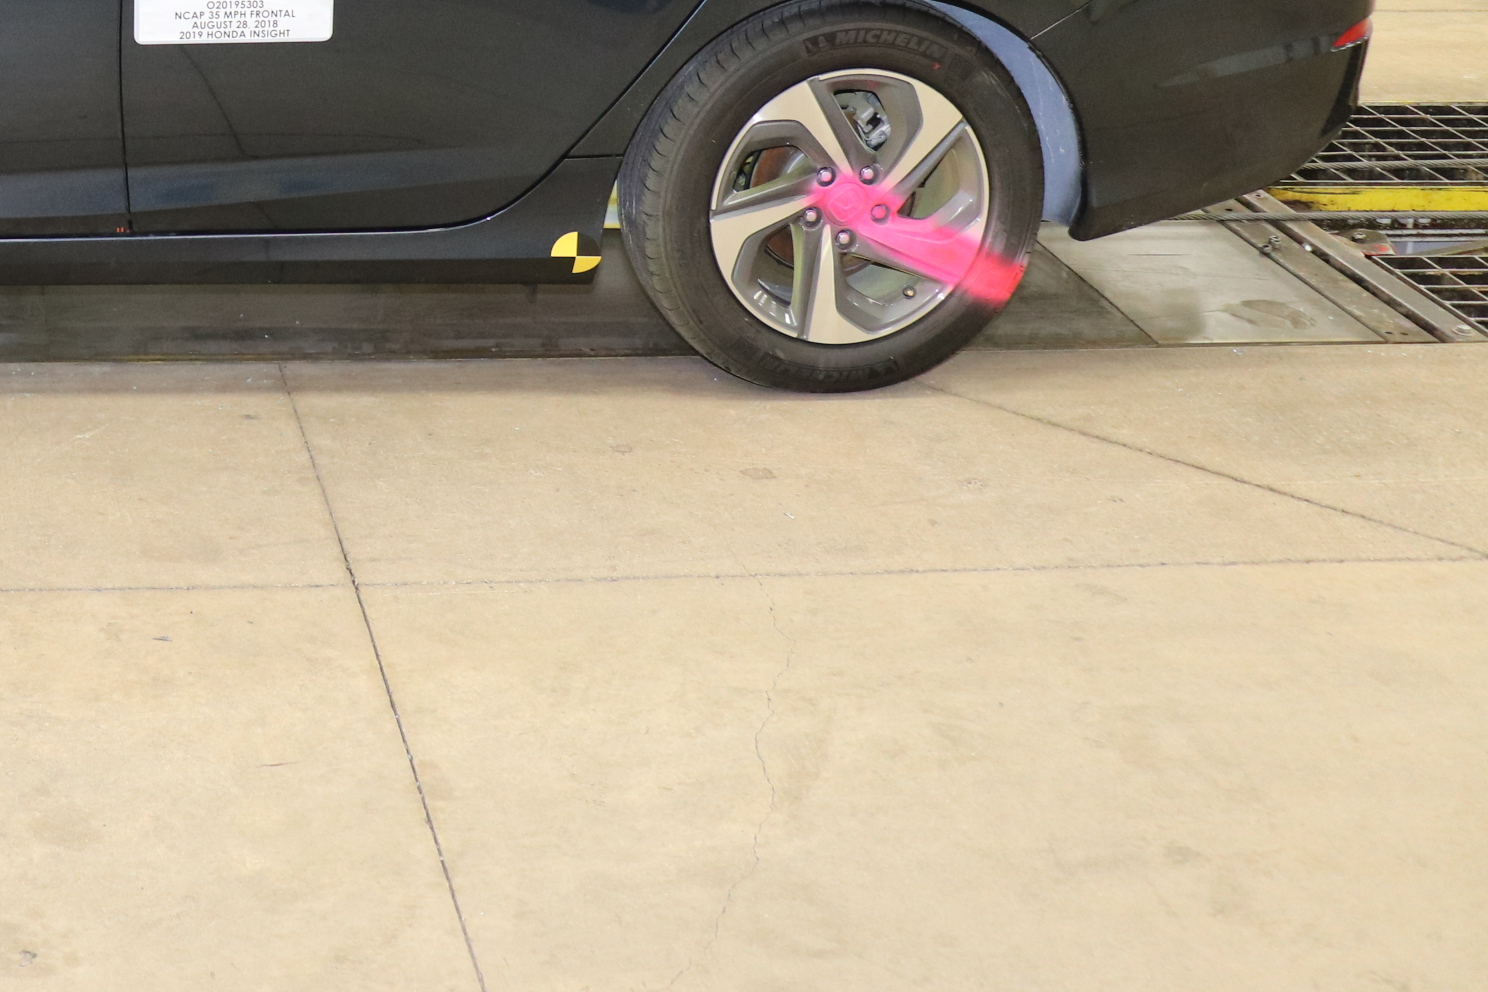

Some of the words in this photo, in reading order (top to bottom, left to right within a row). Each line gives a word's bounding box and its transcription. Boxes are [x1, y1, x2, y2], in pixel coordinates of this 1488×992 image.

[174, 11, 205, 20] NCAP
[208, 11, 221, 20] 35
[224, 10, 247, 19] MPH
[250, 9, 295, 19] FRONTAL
[192, 20, 233, 30] AUGUST
[236, 20, 250, 29] 28,
[254, 19, 278, 28] 2018
[179, 31, 203, 40] 2019
[207, 30, 246, 39] HONDA
[250, 29, 290, 38] INSIGHT
[834, 29, 949, 60] MICHELIN
